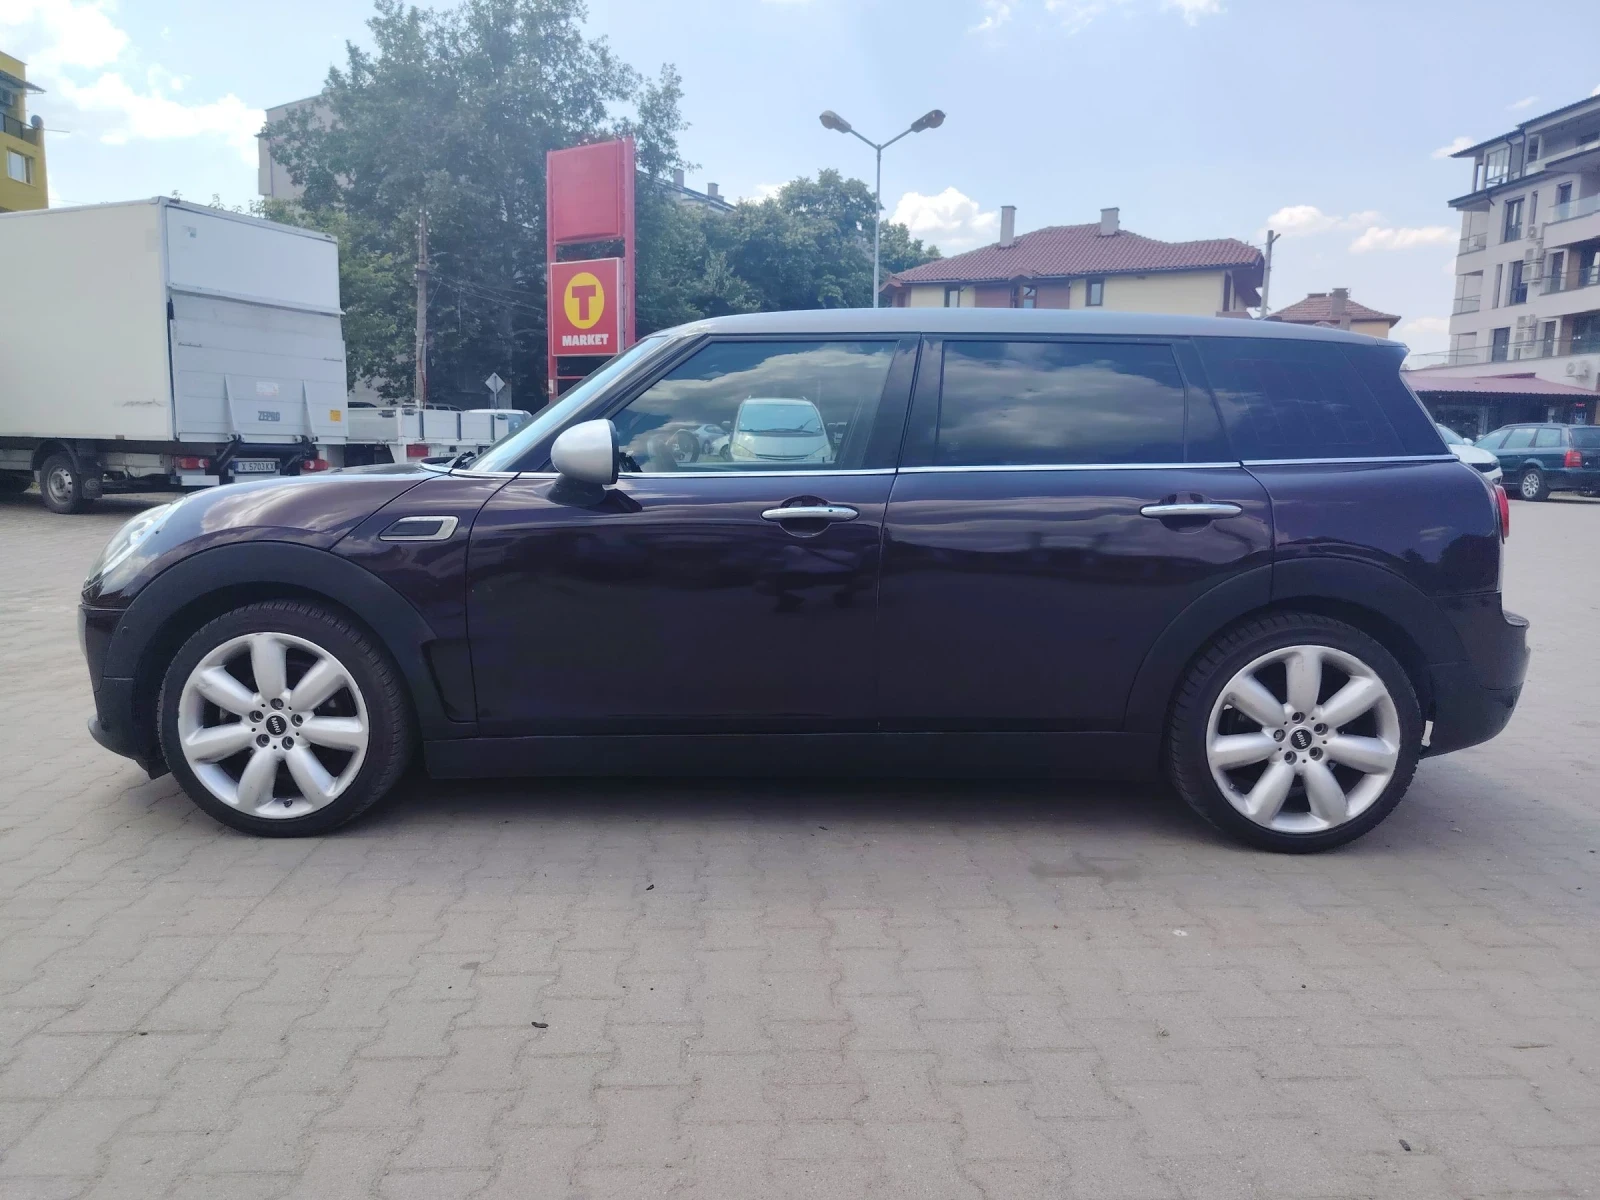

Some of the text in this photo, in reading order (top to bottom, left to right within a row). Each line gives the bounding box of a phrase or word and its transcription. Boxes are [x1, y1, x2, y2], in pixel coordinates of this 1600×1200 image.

[571, 285, 596, 320] T
[562, 334, 609, 346] MARKET
[271, 717, 281, 733] MINI
[1295, 731, 1306, 747] MINI
